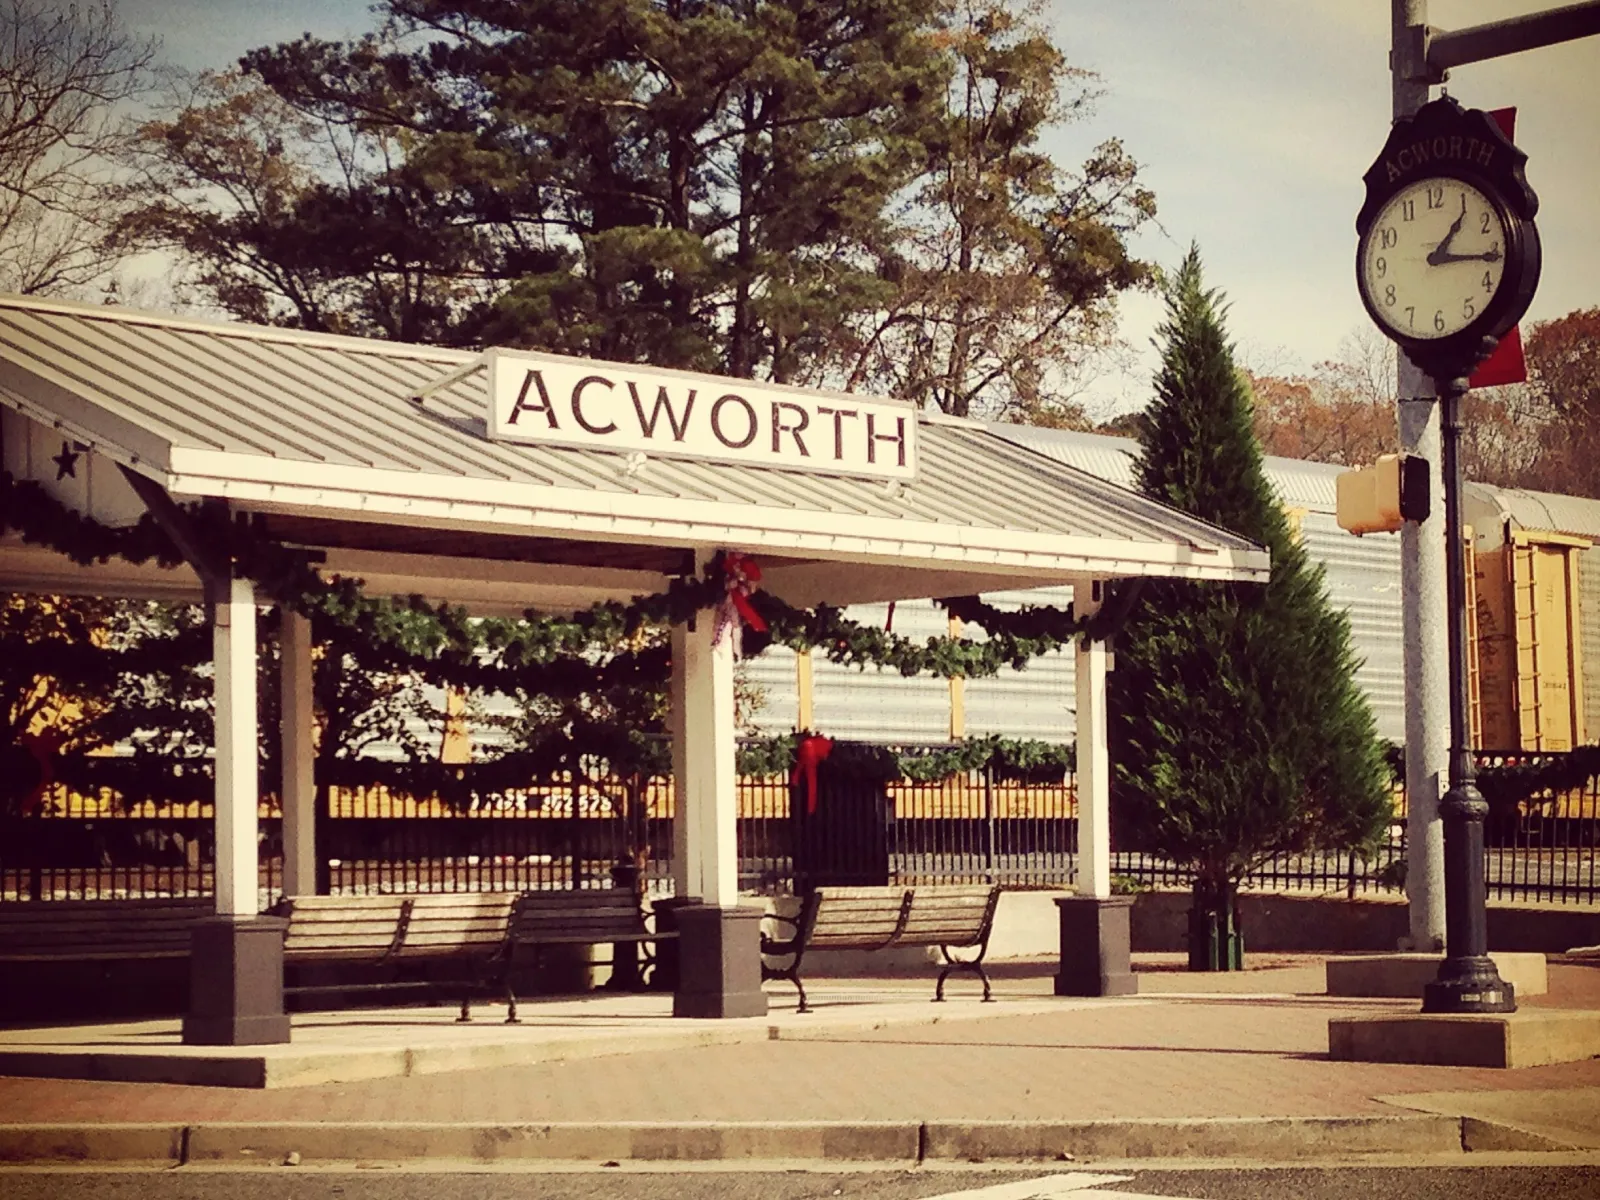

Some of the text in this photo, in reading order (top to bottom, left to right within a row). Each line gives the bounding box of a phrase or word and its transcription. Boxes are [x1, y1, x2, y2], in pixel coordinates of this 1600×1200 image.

[1386, 135, 1495, 182] ACWORTH
[1426, 188, 1444, 209] 12
[1460, 193, 1467, 213] 1
[1402, 200, 1415, 222] 11
[1480, 212, 1491, 234] 2
[1381, 227, 1398, 248] 10
[1376, 257, 1387, 278] 9
[1481, 271, 1493, 293] 4
[1385, 285, 1396, 306] 8
[1405, 307, 1416, 328] 7
[1463, 296, 1475, 318] 5
[1434, 310, 1445, 332] 6
[505, 368, 907, 468] ACWORTH
